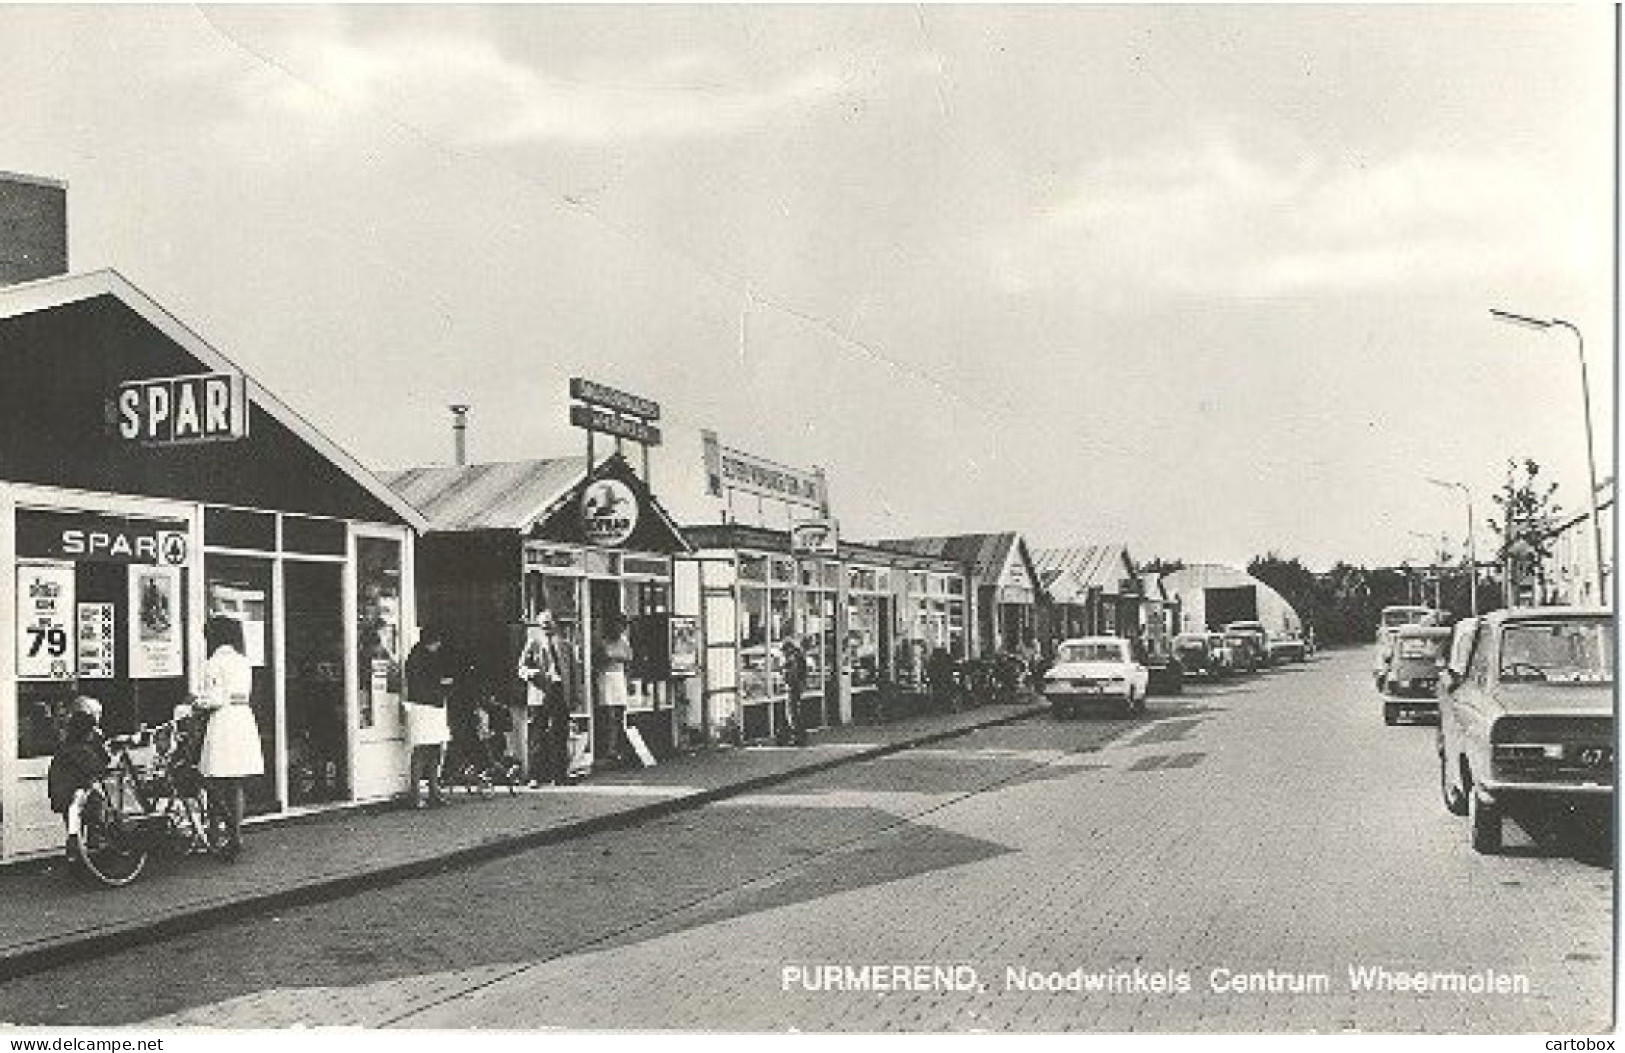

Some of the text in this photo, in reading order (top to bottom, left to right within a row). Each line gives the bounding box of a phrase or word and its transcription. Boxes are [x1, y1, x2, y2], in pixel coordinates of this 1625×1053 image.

[118, 380, 229, 439] SPAR
[62, 530, 156, 557] SPAR
[27, 627, 66, 658] 79
